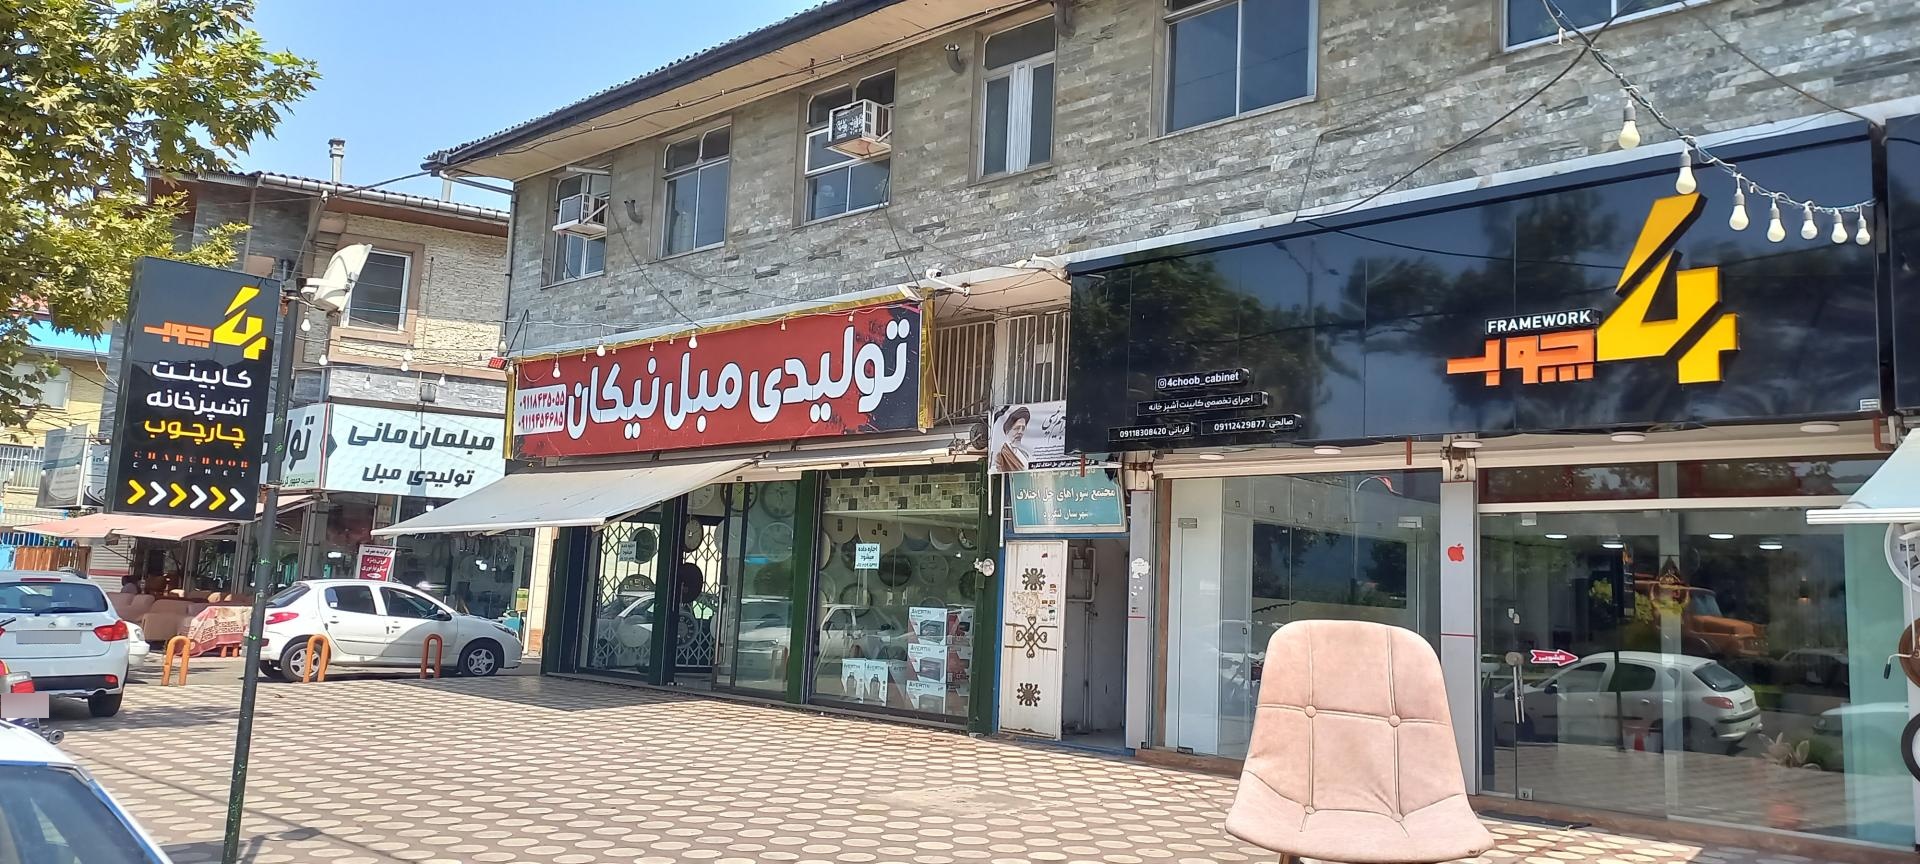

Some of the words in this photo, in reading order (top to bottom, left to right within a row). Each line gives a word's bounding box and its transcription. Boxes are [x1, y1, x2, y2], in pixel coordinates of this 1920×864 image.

[1488, 310, 1591, 333] FRAMEWORK
[151, 361, 252, 389] کابینت
[749, 319, 910, 423] تولیدی
[1166, 371, 1239, 388] 4choob_cabinet
[566, 357, 661, 440] نیکان
[664, 353, 742, 433] مبل
[1205, 397, 1231, 408] تخصصی
[1232, 394, 1253, 405] اجرای
[146, 389, 250, 420] آشپزخانه
[1180, 399, 1203, 409] کابینت
[1214, 420, 1266, 431] 09112429877
[1269, 418, 1294, 429] صالحی
[144, 420, 246, 449] چارچوب
[349, 422, 408, 446] مانی
[409, 427, 495, 455] مبلمان
[132, 462, 246, 478] CABINET
[362, 463, 402, 484] مبل
[406, 469, 475, 487] تولیدی
[1043, 487, 1055, 502] حل
[1091, 488, 1115, 501] مجتمع
